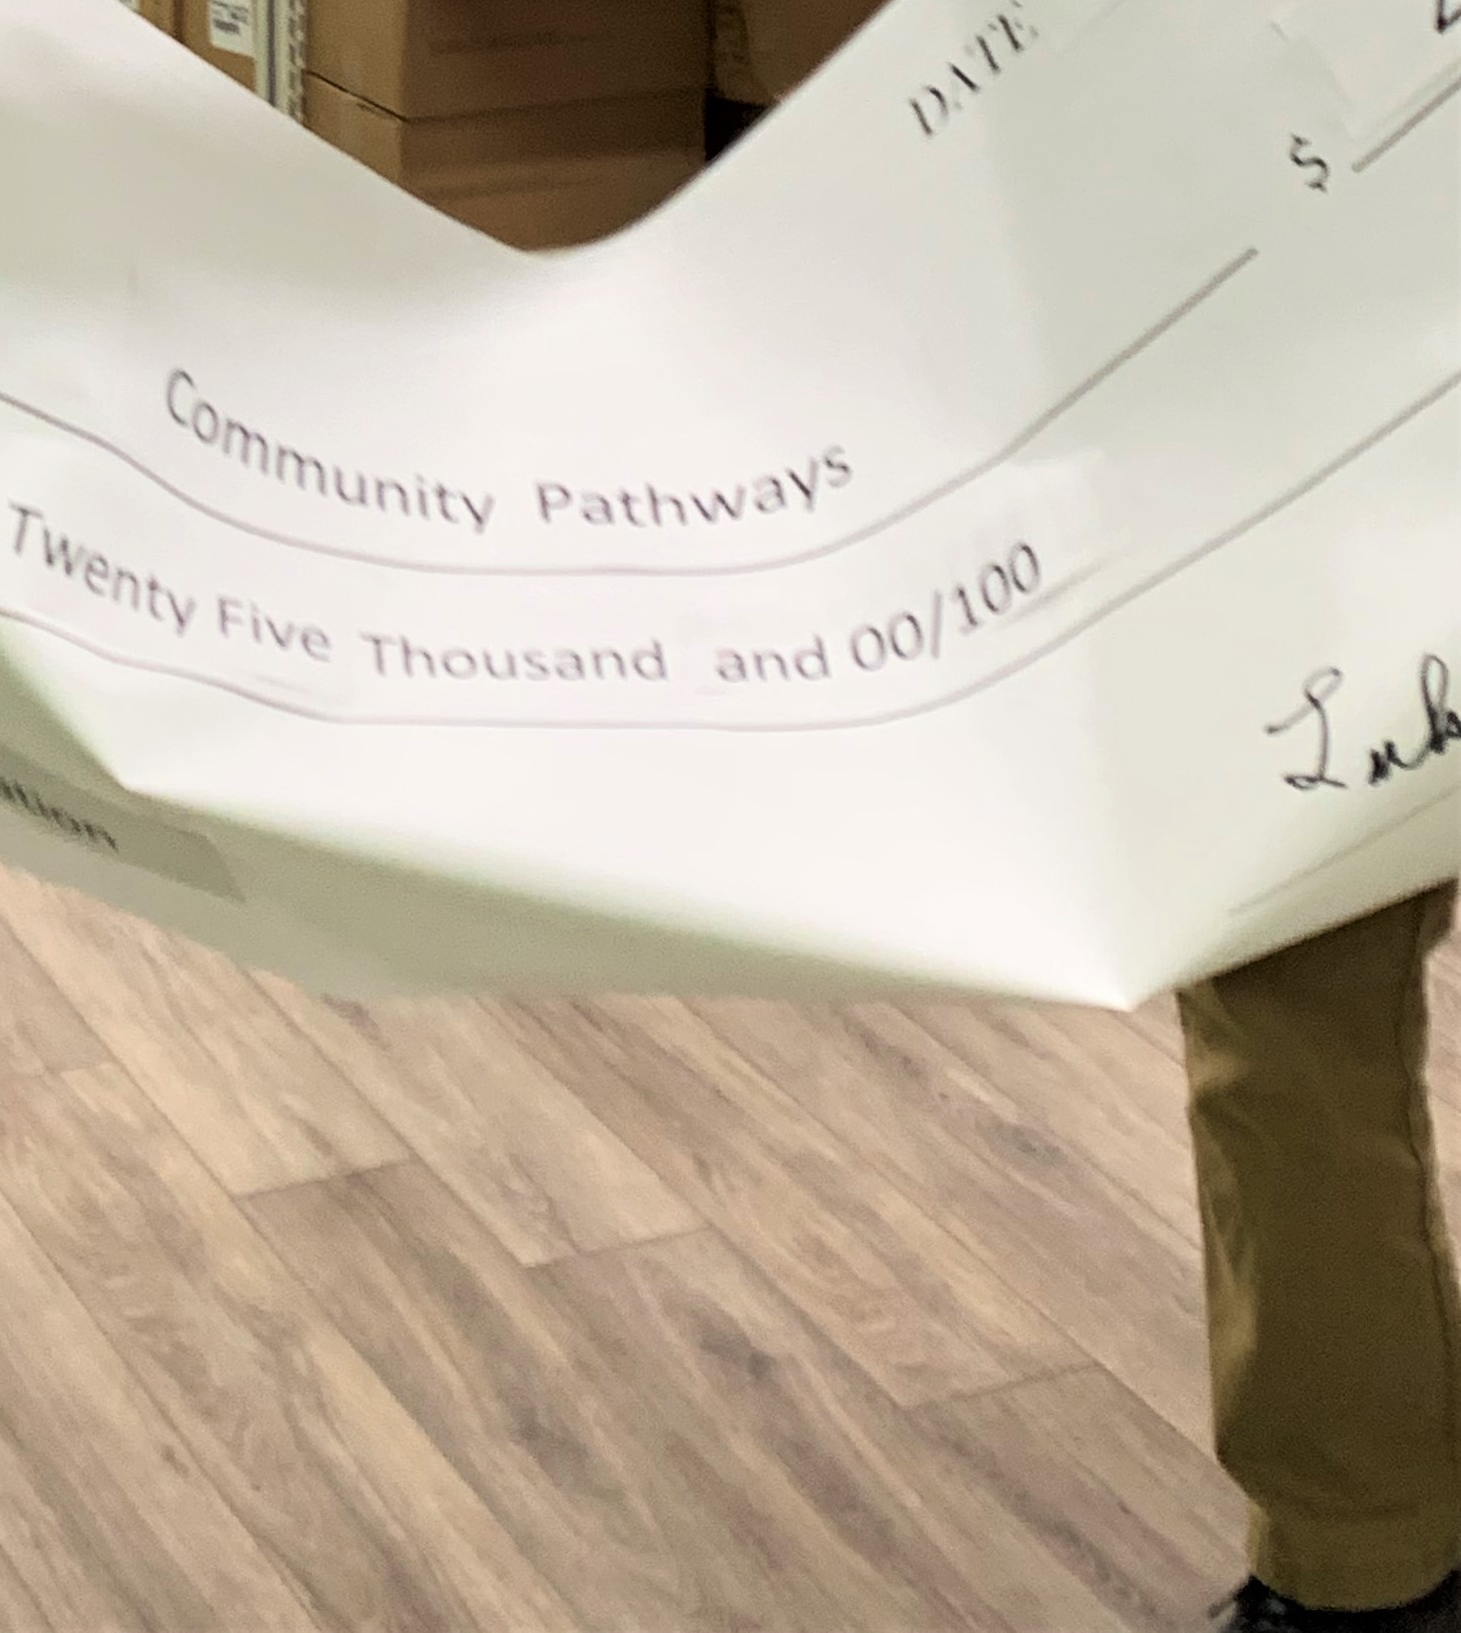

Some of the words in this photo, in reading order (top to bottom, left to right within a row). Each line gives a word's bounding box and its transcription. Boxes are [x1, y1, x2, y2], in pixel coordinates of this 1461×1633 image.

[1287, 133, 1330, 195] $
[165, 367, 494, 535] Community
[537, 443, 854, 528] Pathways
[7, 502, 197, 637] Twenty
[216, 596, 333, 664] Five
[359, 629, 668, 682] Thousand
[713, 633, 832, 684] and
[849, 540, 1042, 672] 00/100
